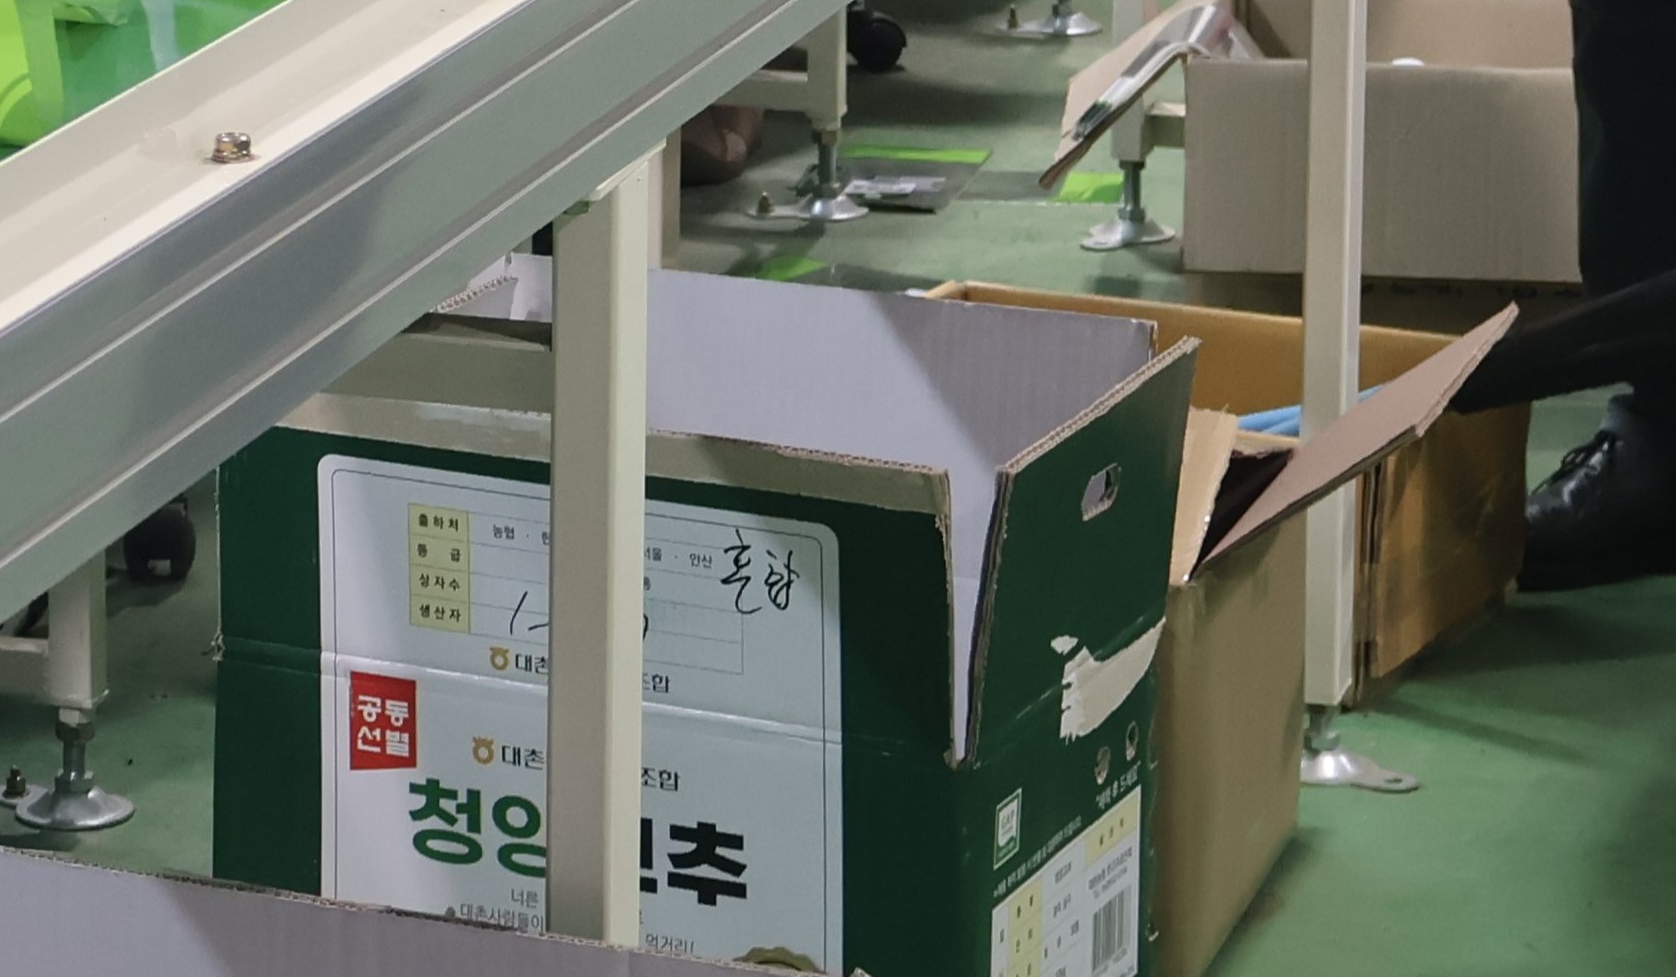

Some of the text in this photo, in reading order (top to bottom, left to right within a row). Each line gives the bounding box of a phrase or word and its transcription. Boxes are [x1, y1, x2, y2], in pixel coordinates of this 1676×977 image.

[418, 513, 459, 532] 출하처
[419, 573, 461, 591] 상자수
[419, 604, 461, 622] 생산자
[357, 694, 410, 728] 공동
[357, 725, 411, 758] 선별
